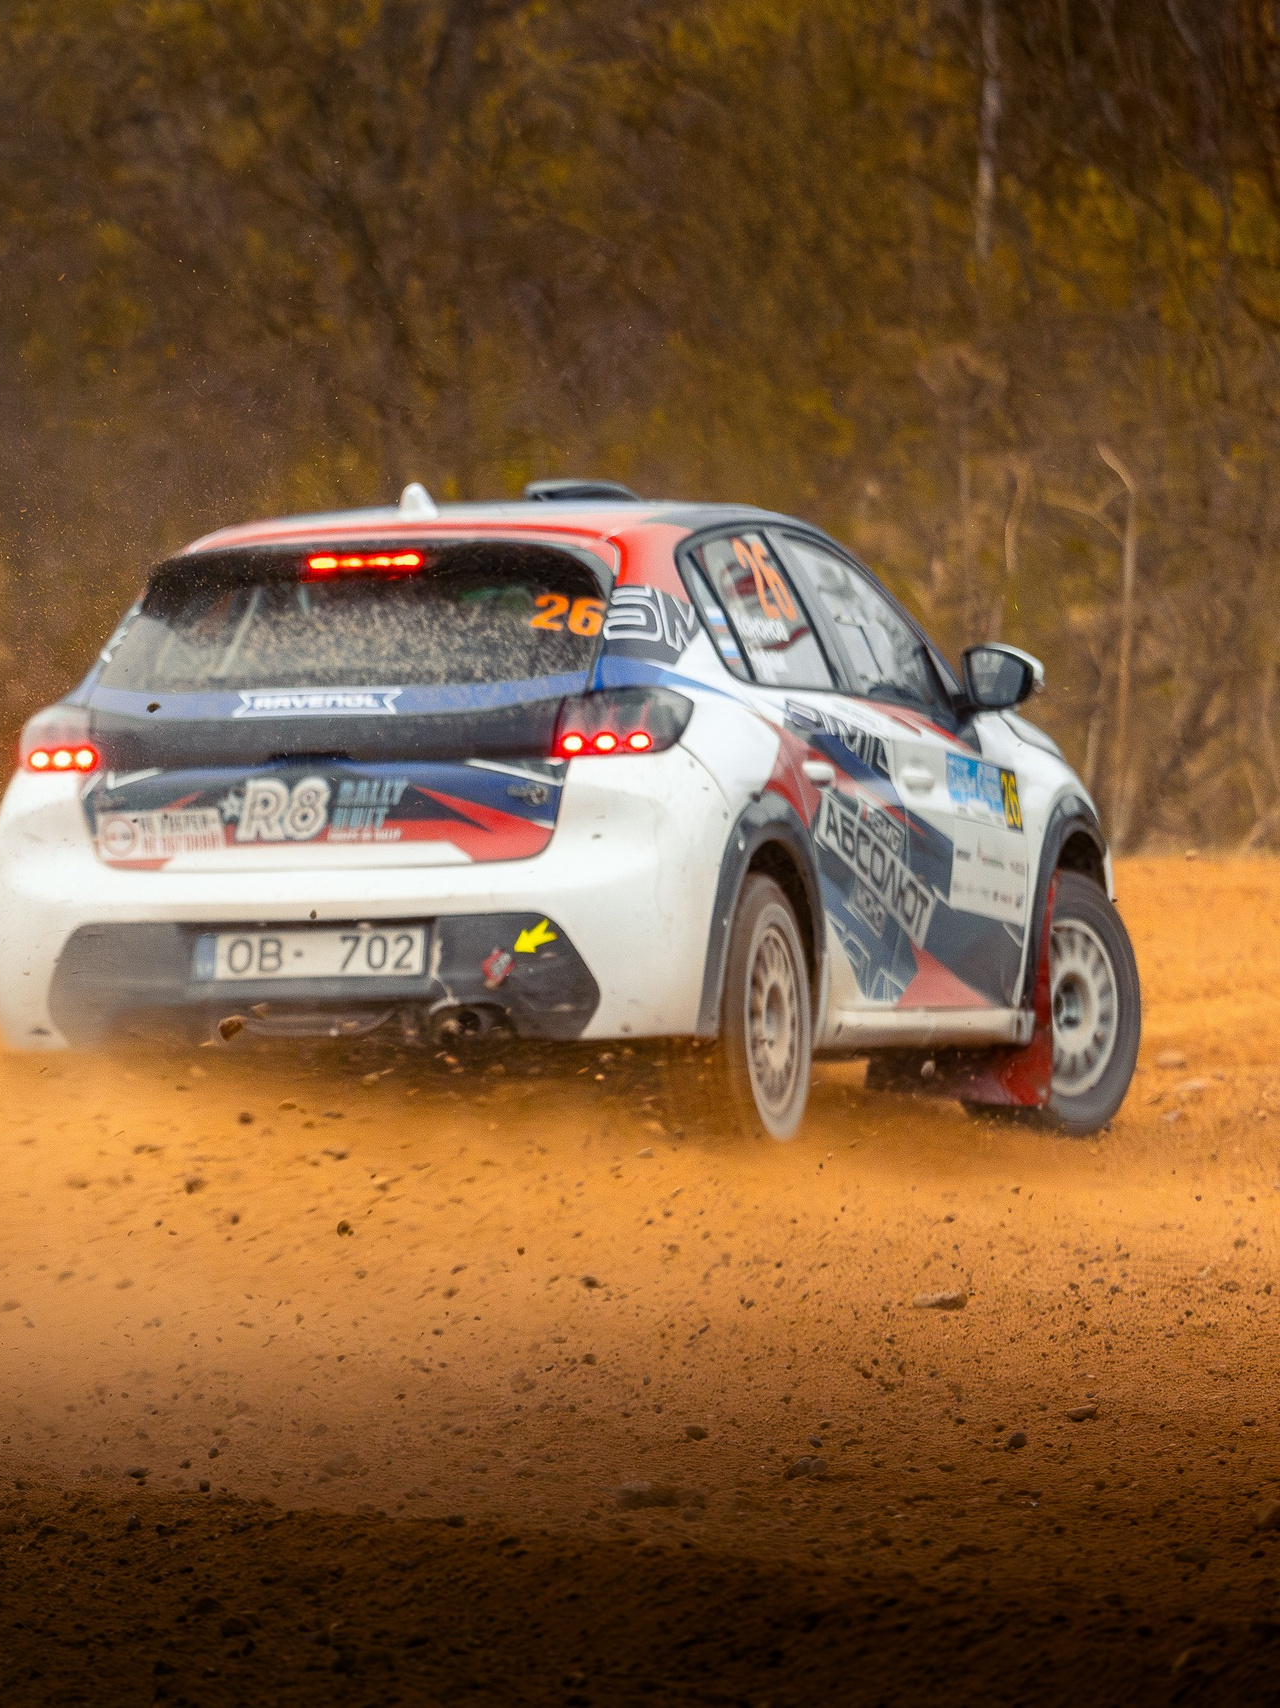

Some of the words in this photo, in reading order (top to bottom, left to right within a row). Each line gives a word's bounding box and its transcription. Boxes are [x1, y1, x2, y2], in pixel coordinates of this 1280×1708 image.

[731, 537, 798, 622] 26
[529, 593, 606, 637] 26
[235, 776, 331, 841] R8
[1000, 770, 1023, 830] 26
[824, 800, 931, 938] АБСОЛЮТ
[339, 934, 414, 971] 702
